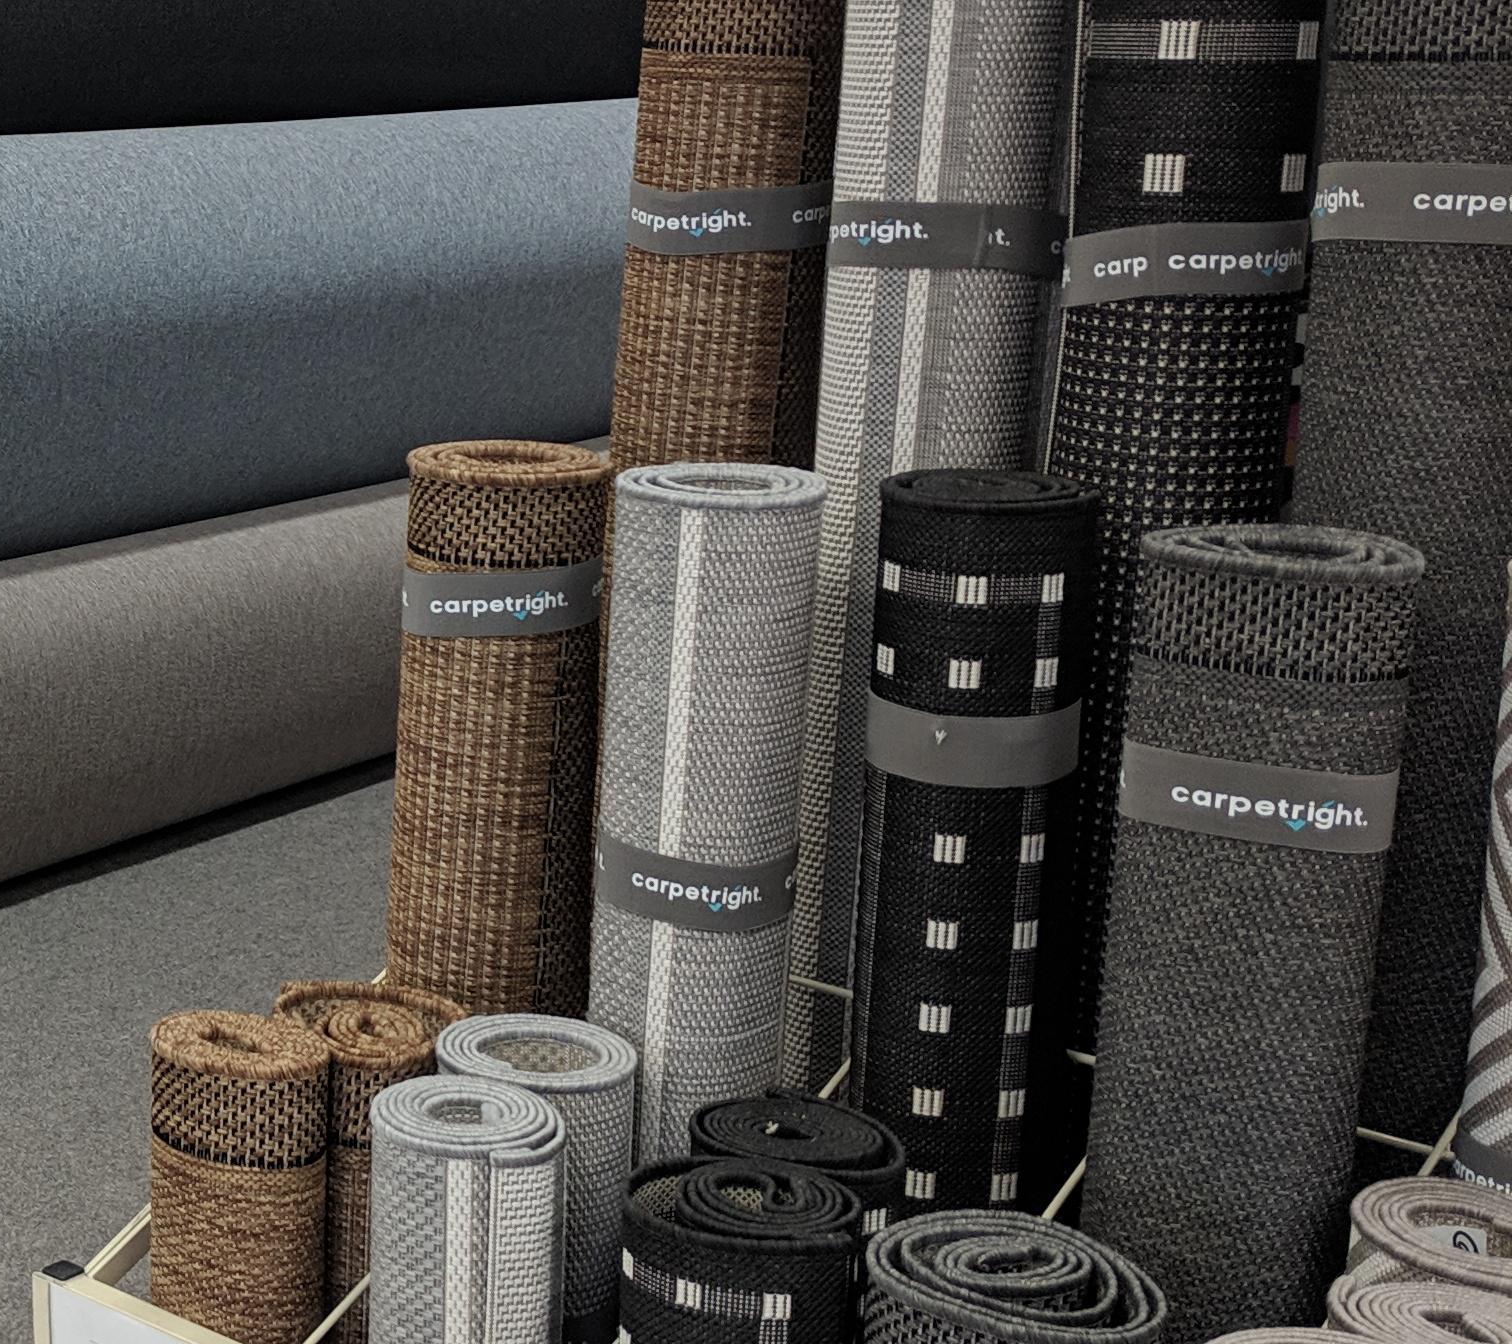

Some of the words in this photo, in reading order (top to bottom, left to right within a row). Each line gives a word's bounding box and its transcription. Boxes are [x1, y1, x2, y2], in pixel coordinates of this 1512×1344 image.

[631, 208, 752, 233] carpetright.
[430, 591, 569, 617] carpetright.
[1170, 784, 1368, 830] carpetright.
[631, 870, 762, 910] carpetright.
